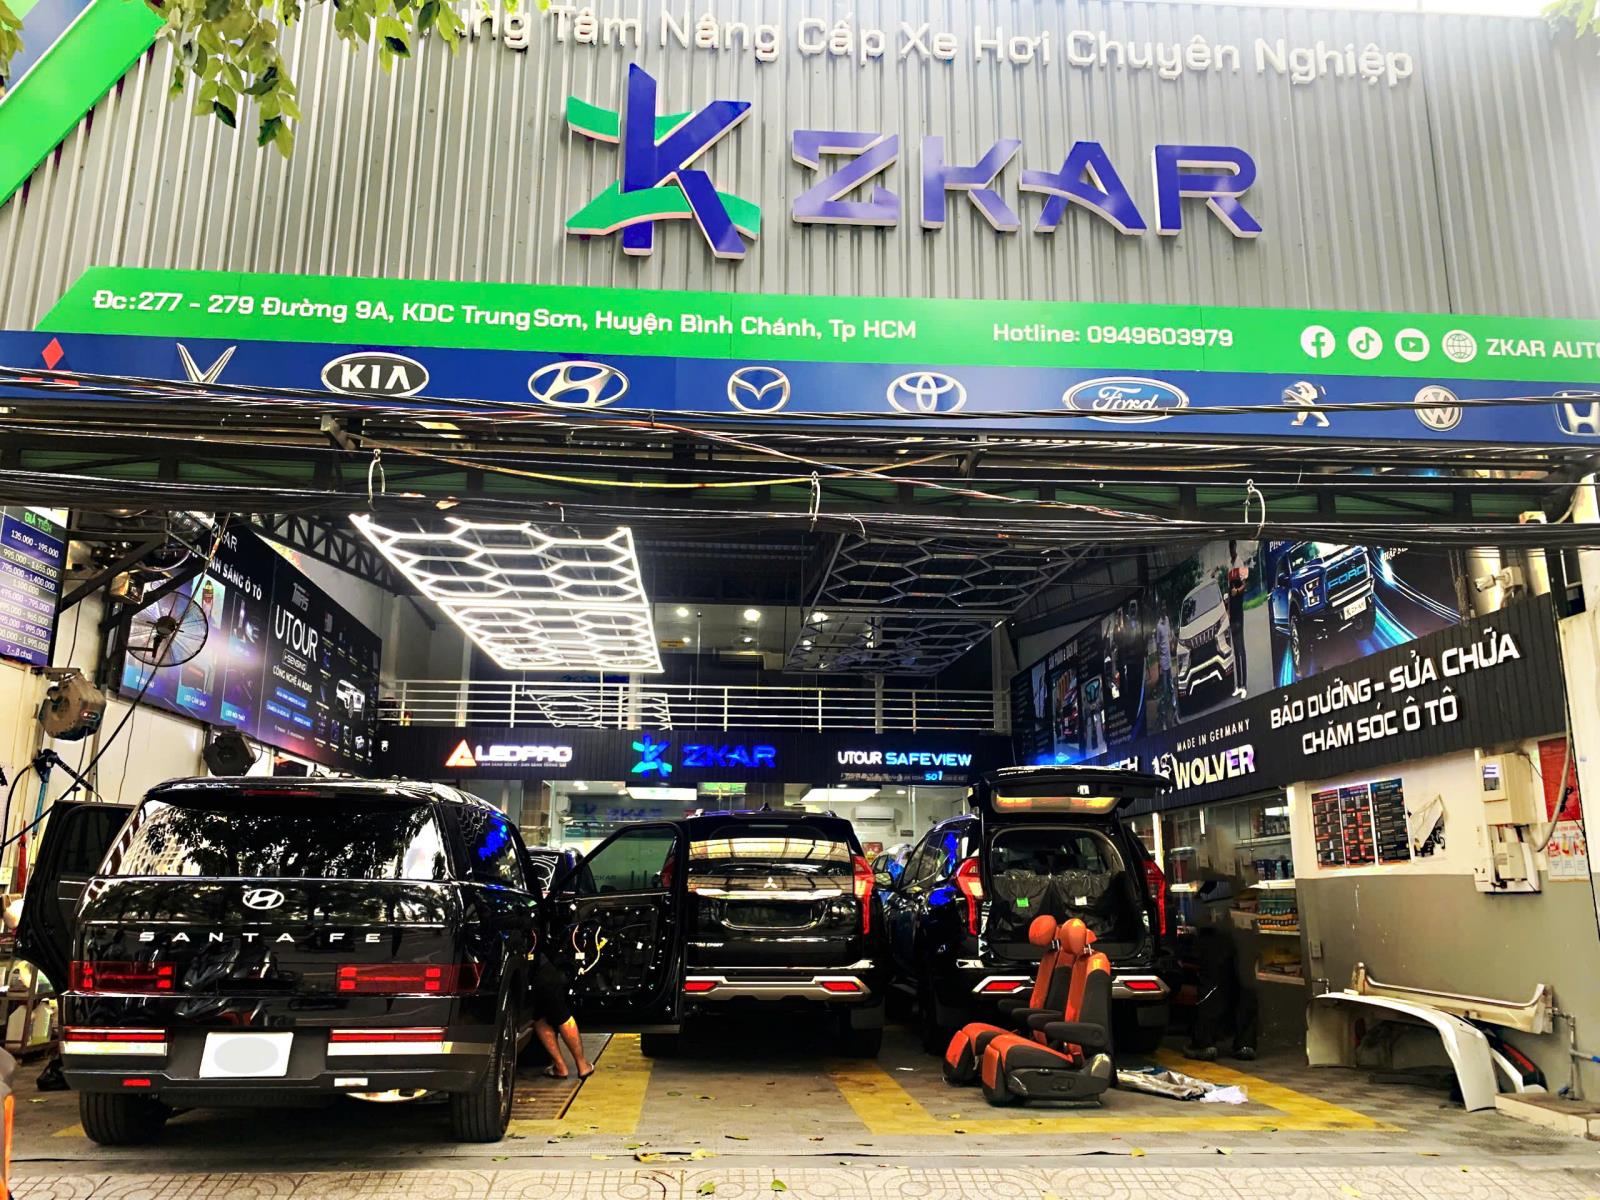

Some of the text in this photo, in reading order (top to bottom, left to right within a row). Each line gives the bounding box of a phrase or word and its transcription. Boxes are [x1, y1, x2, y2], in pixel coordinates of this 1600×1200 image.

[551, 5, 642, 47] Tâm
[660, 9, 781, 62] Nâng
[798, 12, 886, 66] Cấp
[900, 21, 958, 62] Xe
[974, 25, 1050, 65] Hơi
[1066, 30, 1240, 80] Chuyên
[1254, 37, 1414, 88] Nghiệp
[792, 128, 1263, 238] ZKAR
[208, 294, 254, 315] 279
[261, 296, 348, 323] Đường
[355, 300, 394, 323] 9A,
[402, 302, 454, 323] KDC
[596, 310, 673, 336] Huyện
[680, 312, 734, 334] Bình
[740, 314, 822, 340] Chánh,
[828, 319, 856, 342] Tp
[864, 319, 917, 339] HCM
[993, 323, 1234, 347] Hotline: 0949603979
[1485, 338, 1546, 357] ZKAR
[341, 363, 411, 391] KIA
[1091, 385, 1160, 411] Ford
[222, 563, 244, 588] SÁNG
[1328, 563, 1367, 590] FORD
[275, 604, 319, 662] UTOUR
[1270, 688, 1304, 730] BẢO
[1308, 676, 1372, 717] DƯỠNG
[1389, 650, 1438, 693] SỬA
[1442, 627, 1520, 678] CHỮA
[1302, 686, 1459, 755] CHĂM SÓC Ô TÔ
[1176, 718, 1250, 752] MADE IN GERMANY
[682, 744, 777, 768] ZKAR
[837, 750, 972, 767] UTOUR SAFEVIEW
[1172, 744, 1256, 790] WOLVER
[139, 931, 381, 944] SANTA FE
